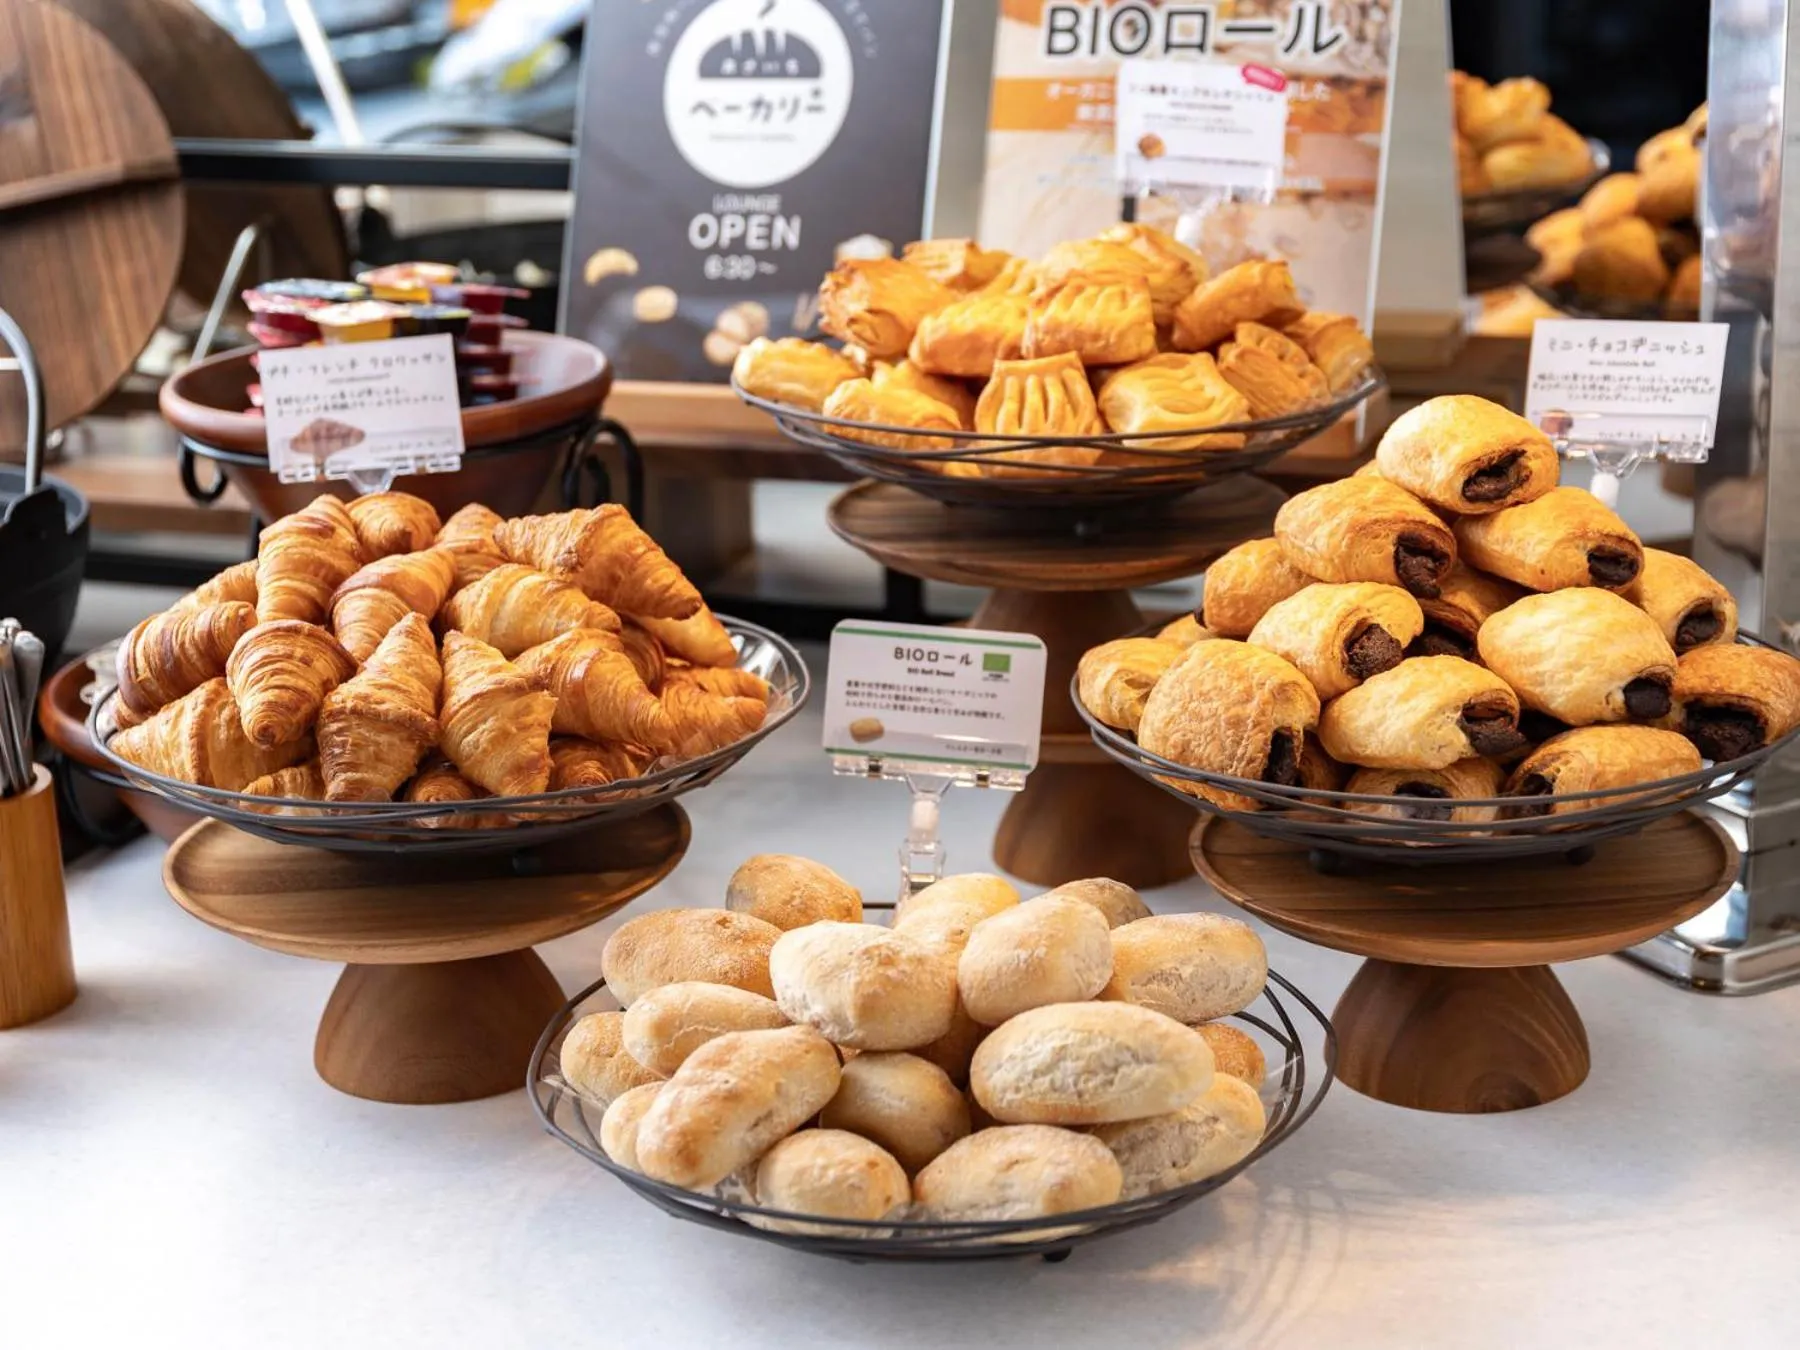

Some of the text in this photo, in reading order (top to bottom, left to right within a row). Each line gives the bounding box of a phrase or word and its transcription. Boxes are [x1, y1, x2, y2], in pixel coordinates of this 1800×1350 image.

[1046, 6, 1342, 55] BIOロール
[688, 213, 802, 251] OPEN
[894, 646, 973, 666] BIOロール
